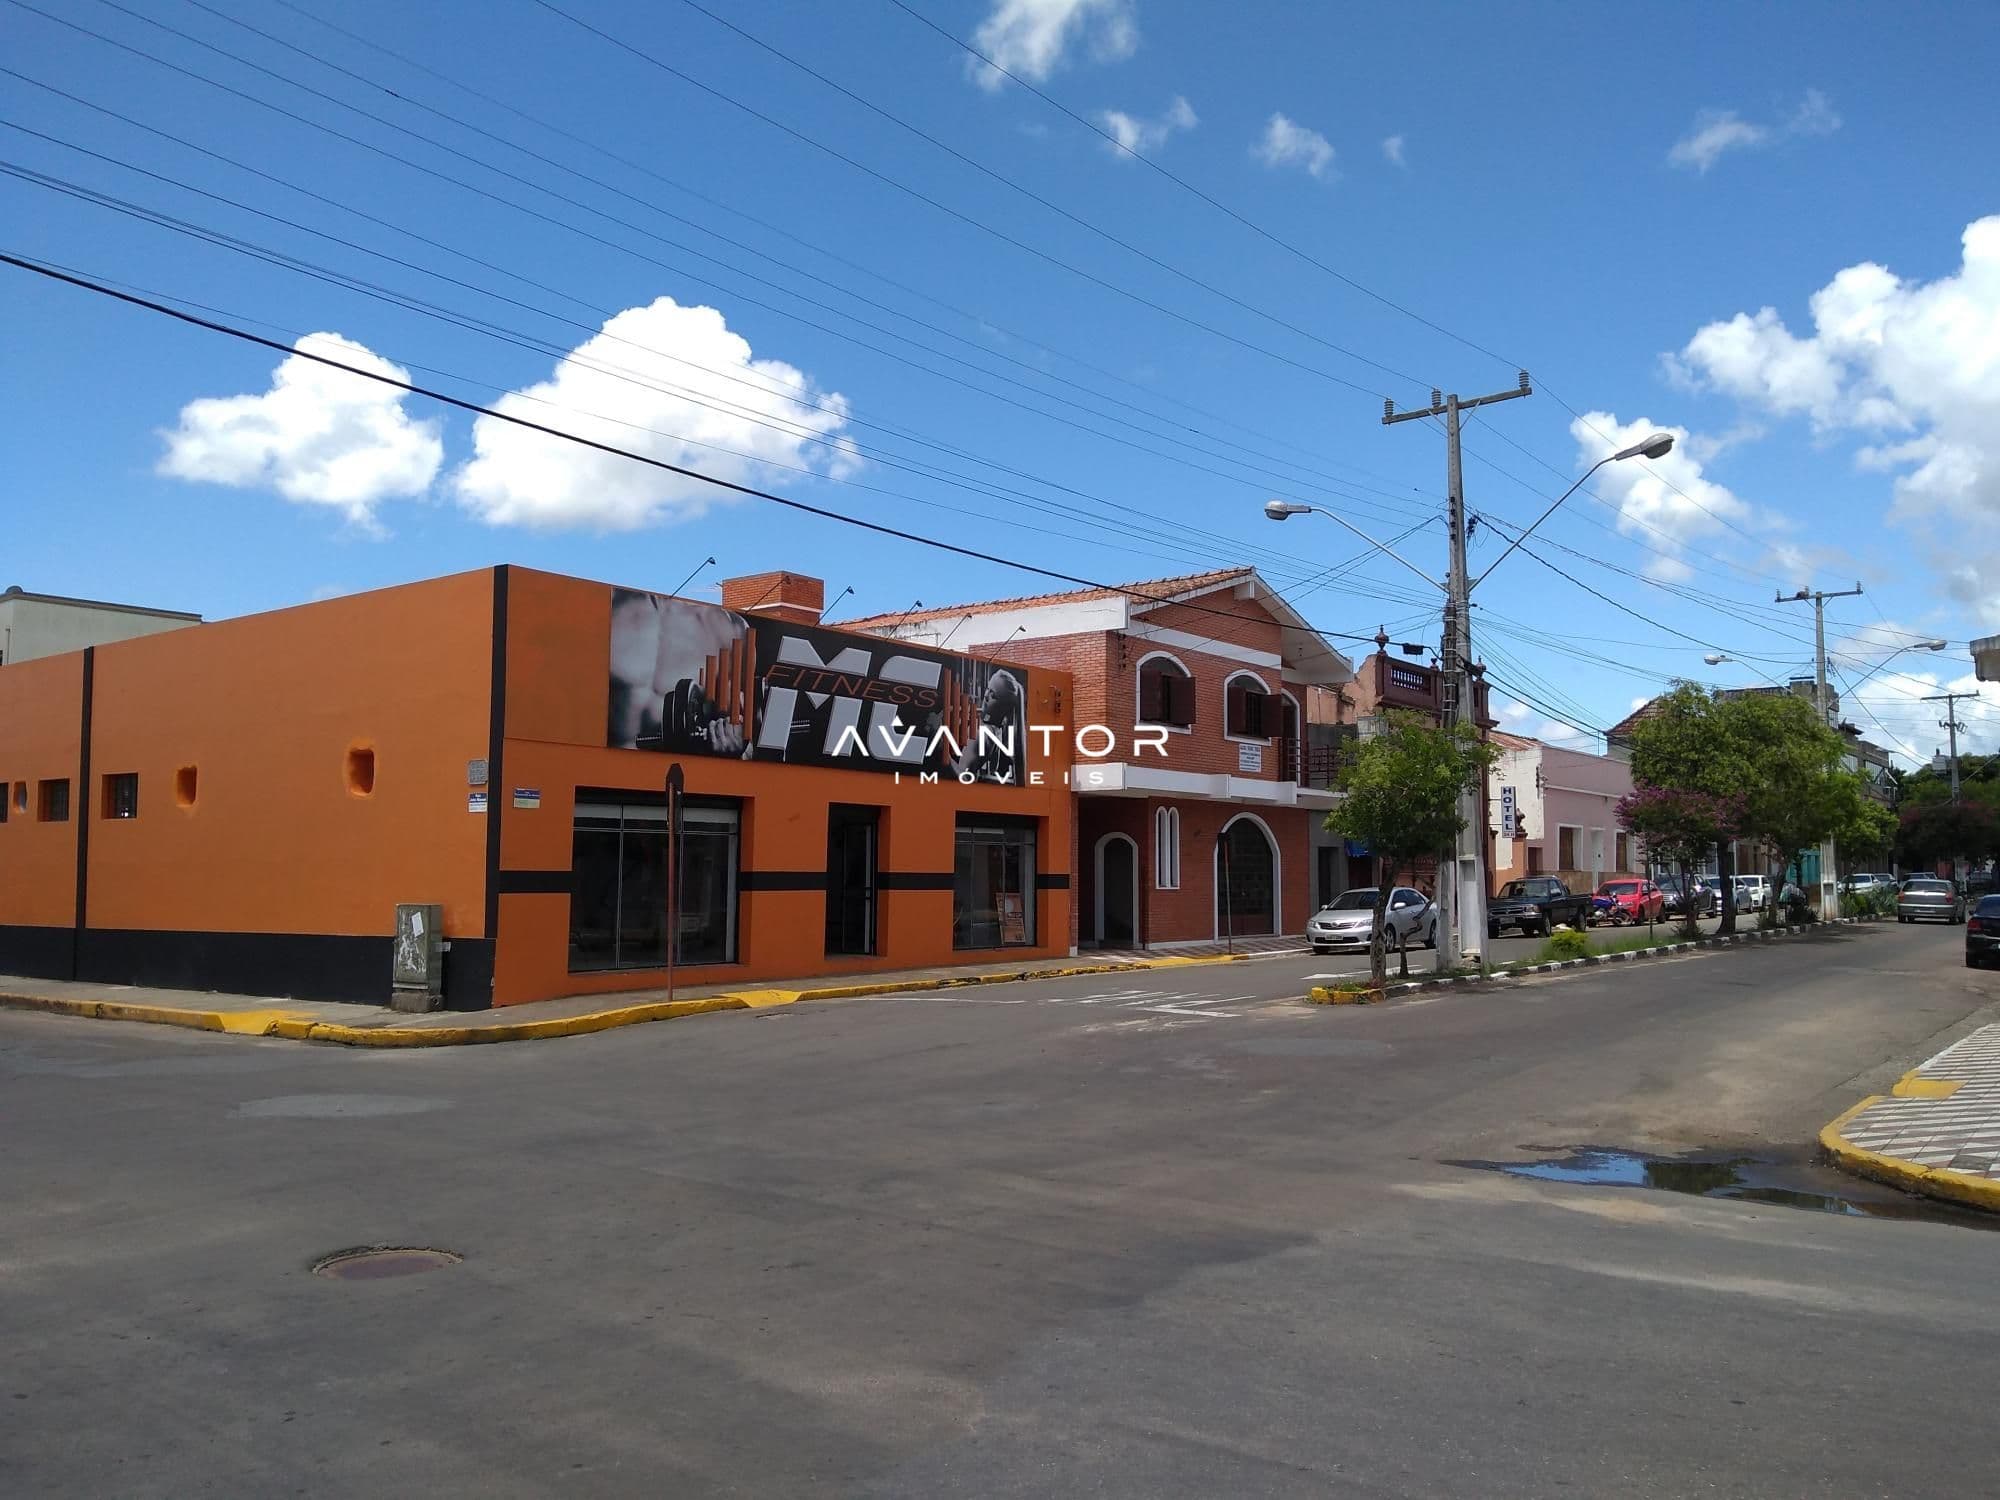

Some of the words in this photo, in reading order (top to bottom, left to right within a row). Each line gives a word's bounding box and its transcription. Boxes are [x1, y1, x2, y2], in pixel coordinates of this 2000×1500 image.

[757, 635, 942, 765] MC
[766, 664, 939, 708] FITNESS
[1503, 787, 1513, 830] HOTEL
